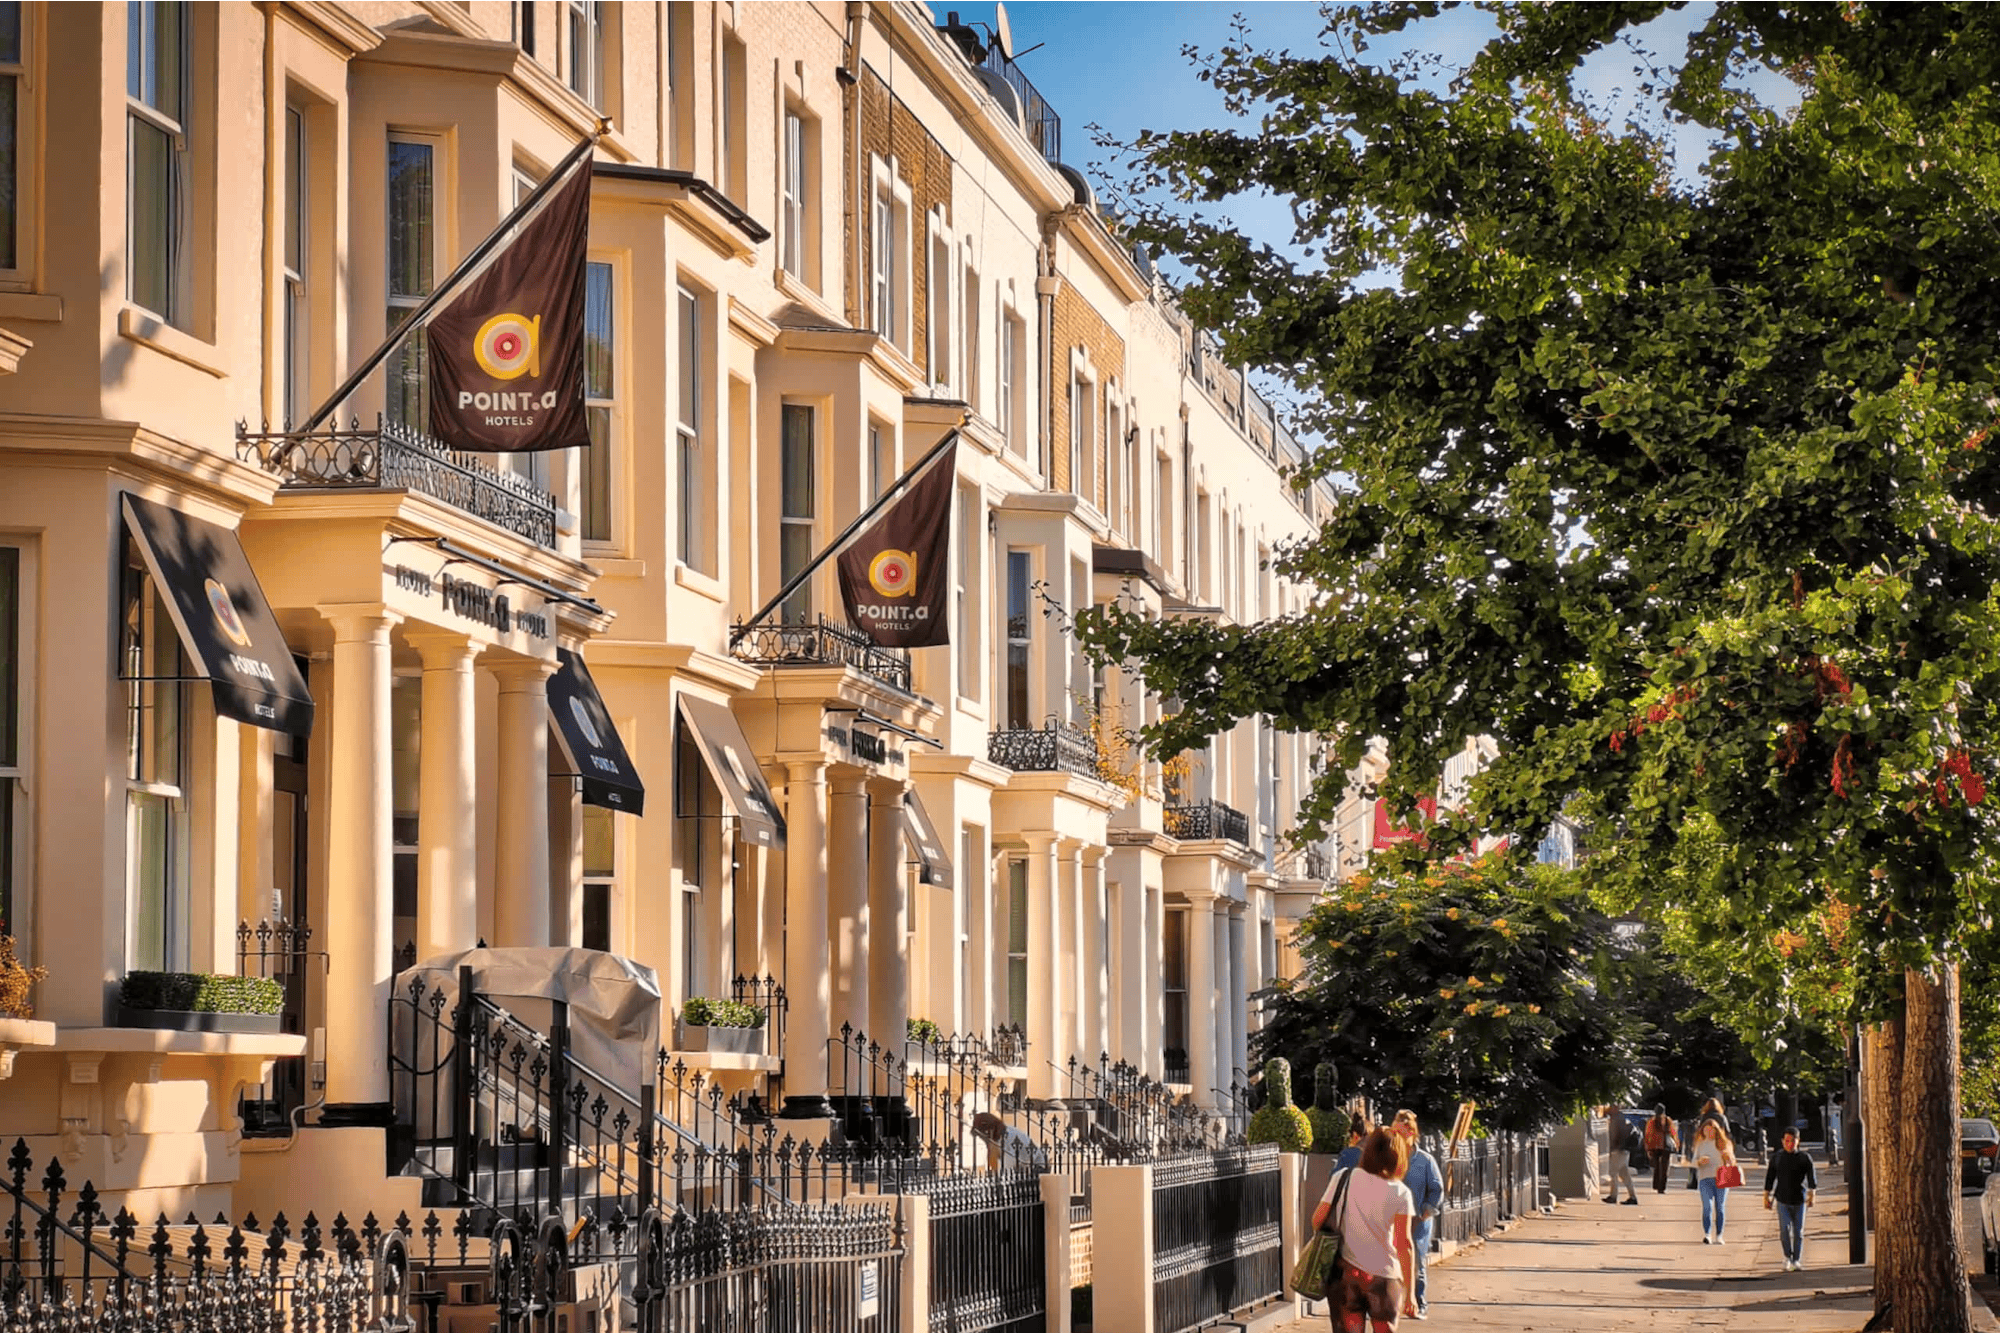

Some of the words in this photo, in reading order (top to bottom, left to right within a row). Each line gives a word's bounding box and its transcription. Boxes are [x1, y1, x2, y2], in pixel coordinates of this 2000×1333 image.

[458, 390, 557, 411] POINT.a
[485, 415, 534, 426] HOTELS
[857, 604, 929, 620] POINT.a
[875, 622, 910, 631] HOTELS
